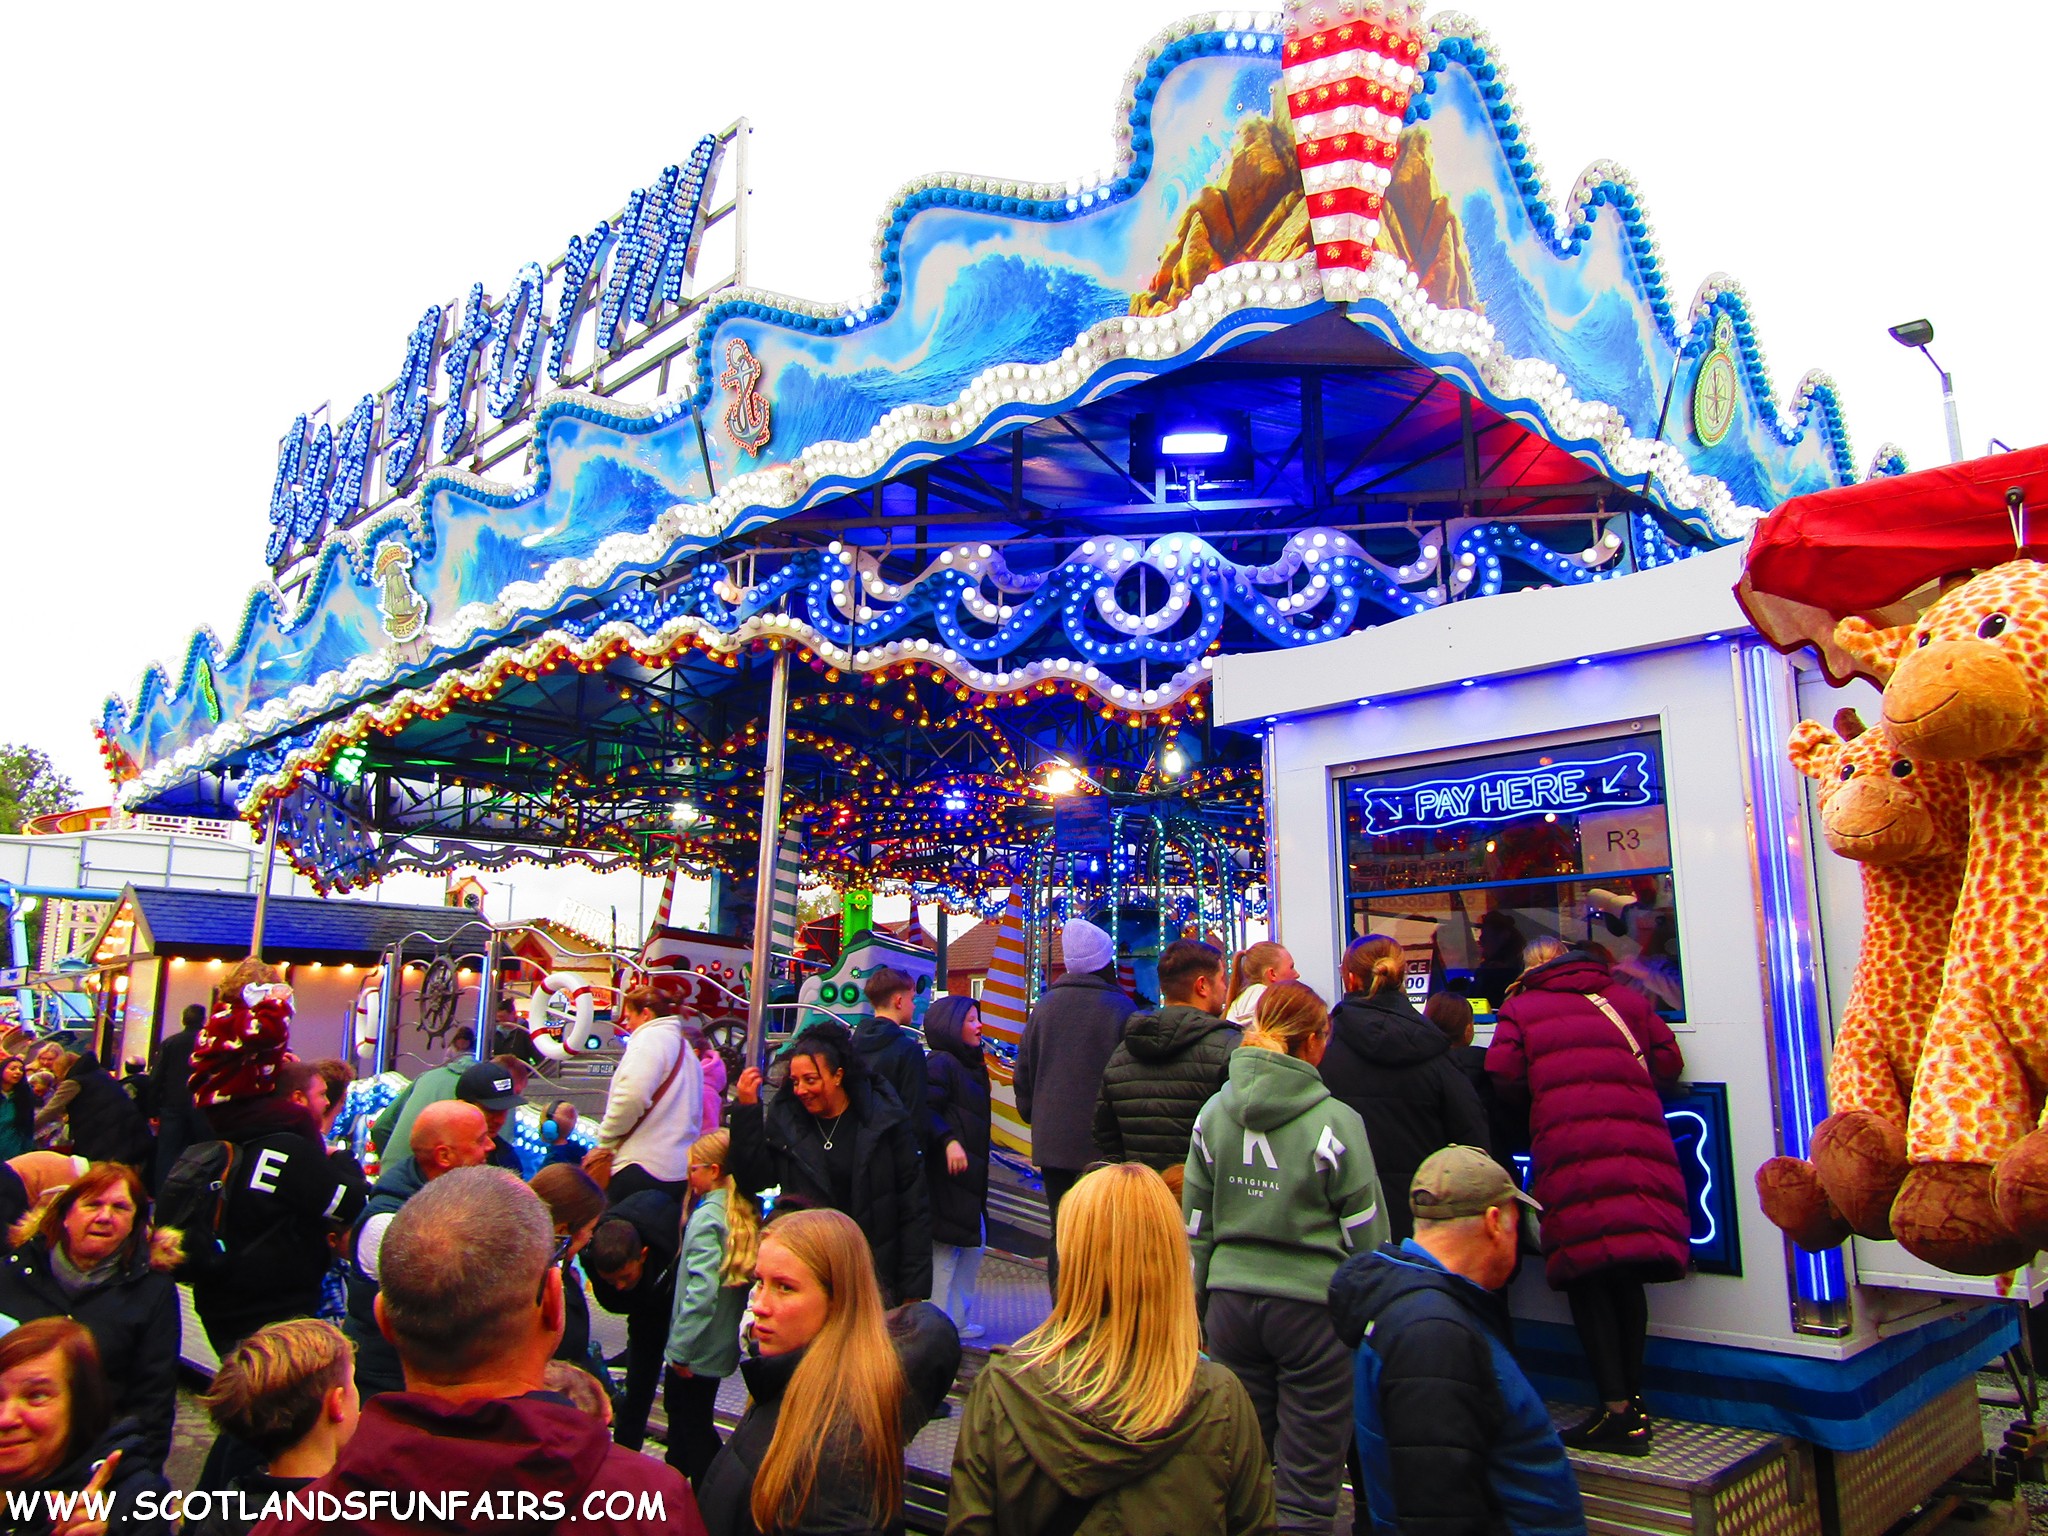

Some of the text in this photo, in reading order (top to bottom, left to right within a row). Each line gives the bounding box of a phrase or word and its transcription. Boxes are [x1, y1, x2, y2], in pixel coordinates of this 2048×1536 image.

[1415, 769, 1588, 821] PAY HERE
[1607, 829, 1641, 852] R3
[250, 1148, 290, 1194] E
[1229, 1175, 1281, 1191] ORIGINAL
[1247, 1189, 1264, 1198] LIFE
